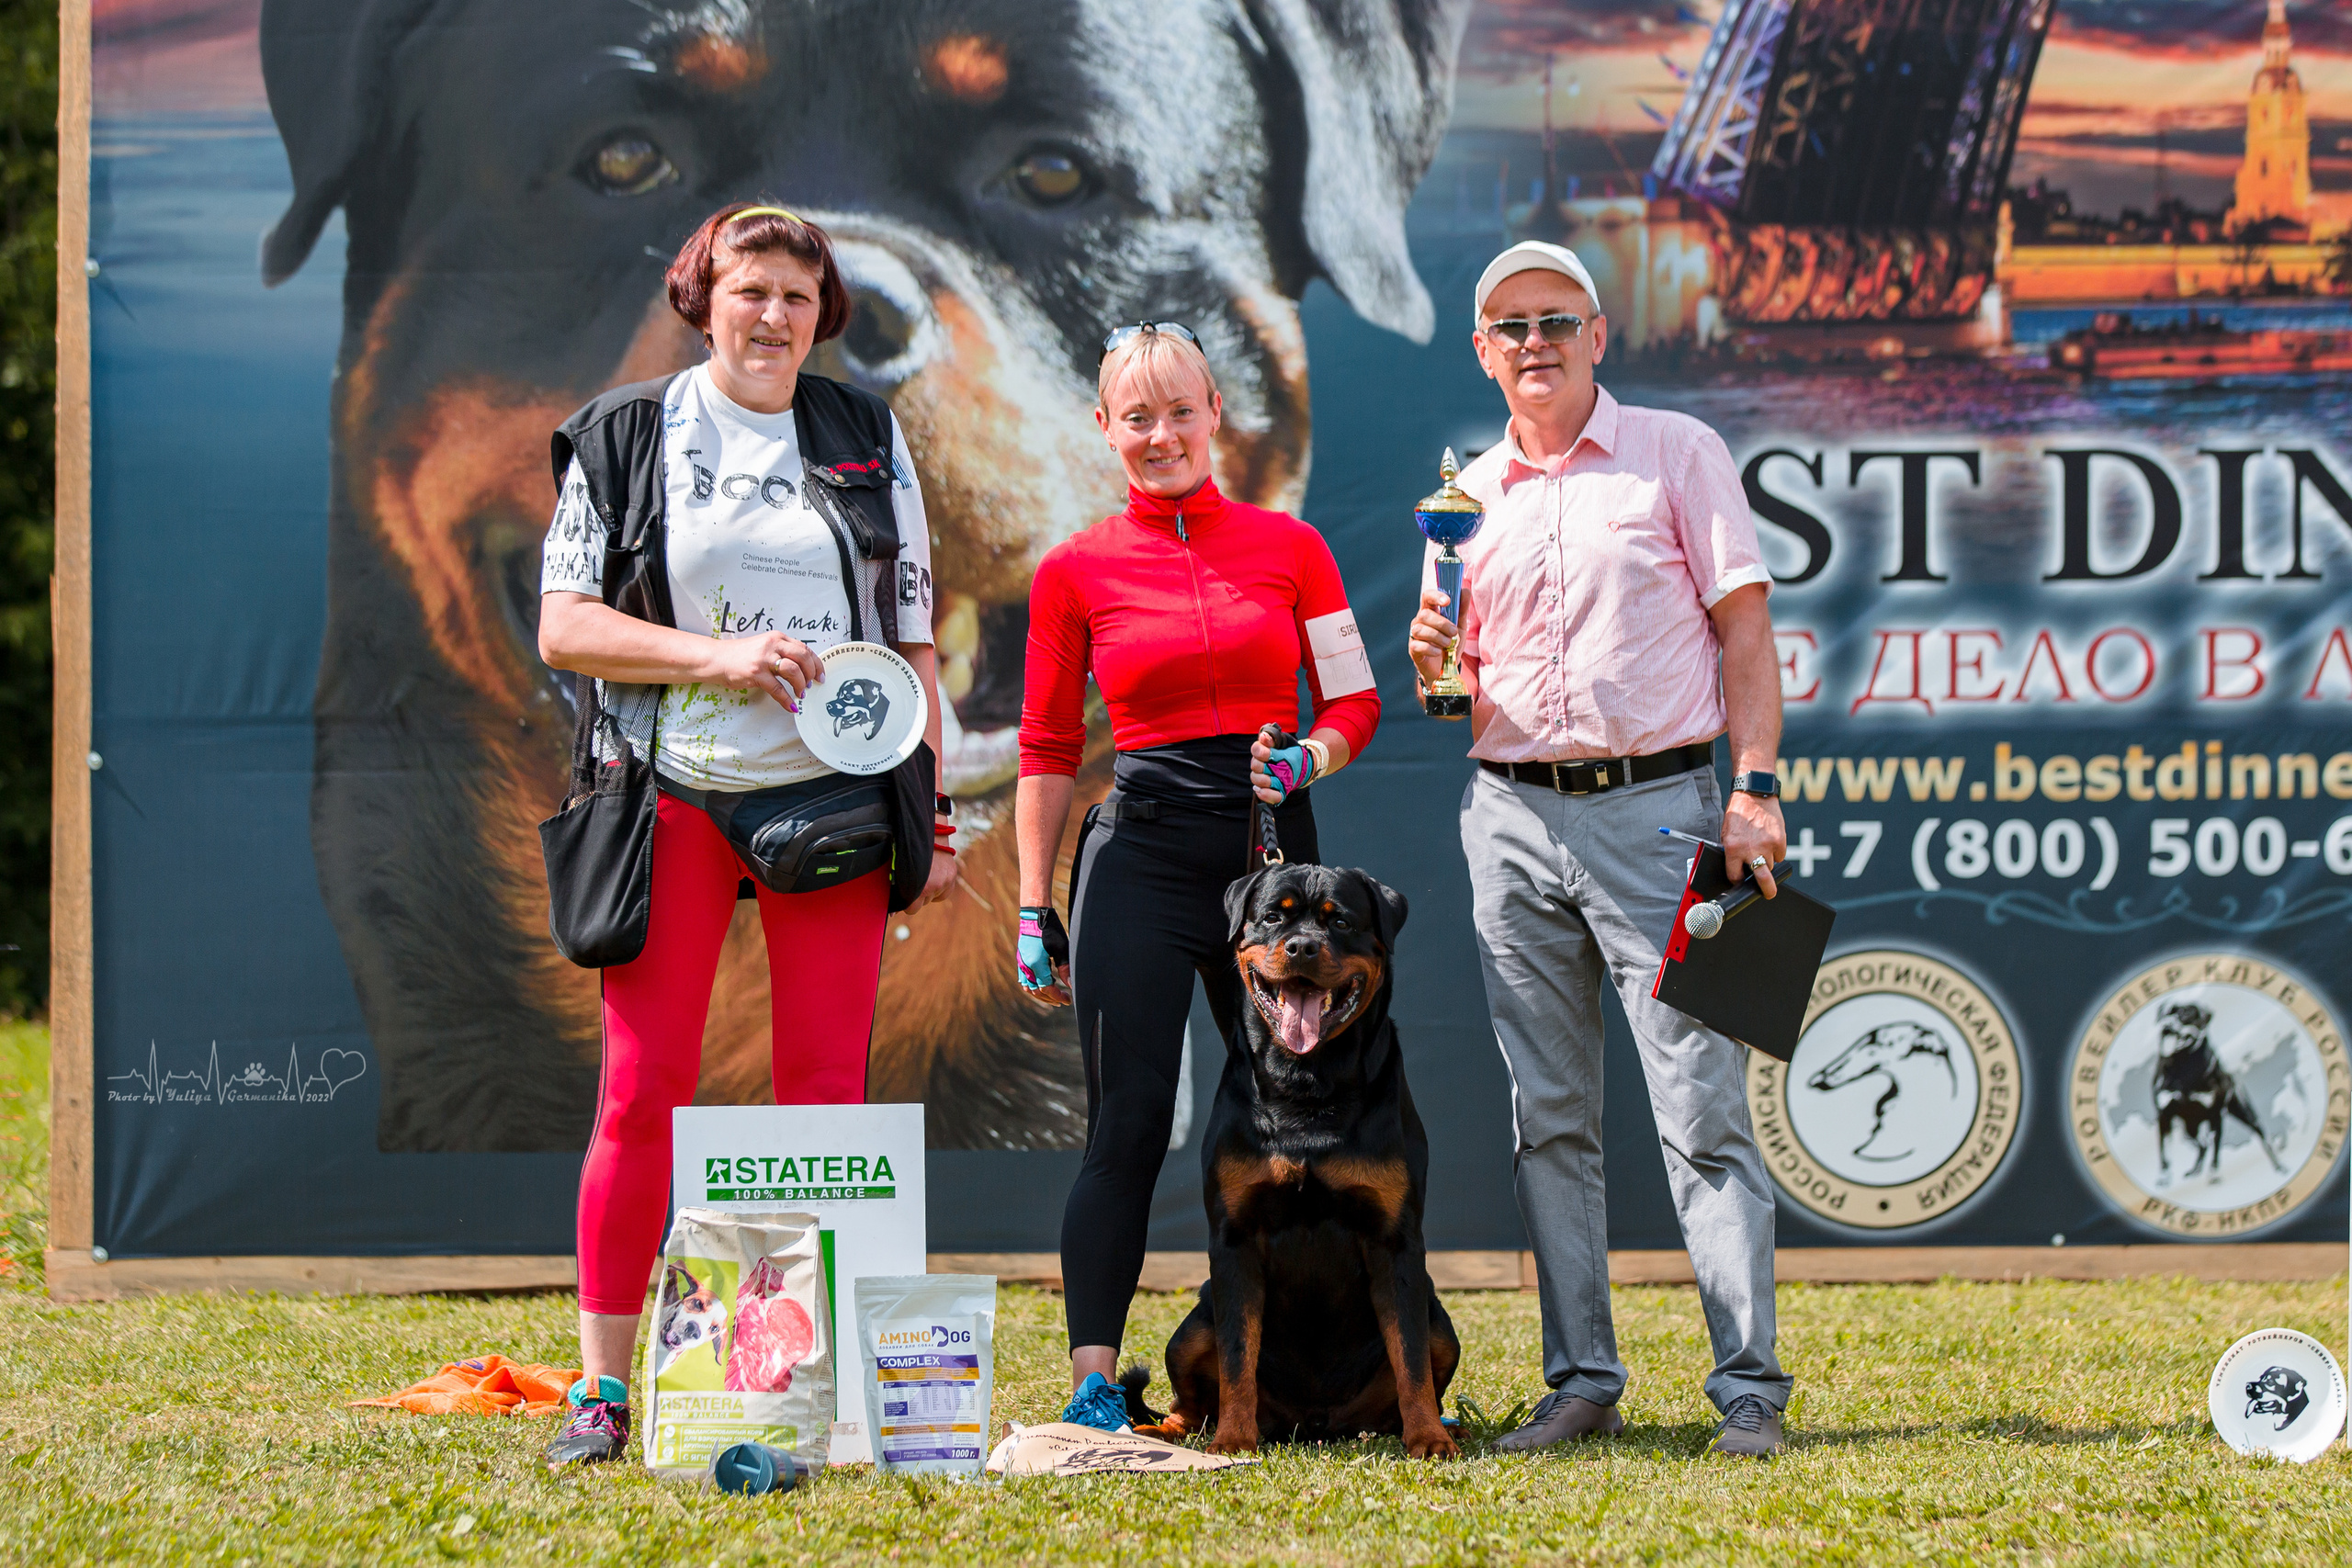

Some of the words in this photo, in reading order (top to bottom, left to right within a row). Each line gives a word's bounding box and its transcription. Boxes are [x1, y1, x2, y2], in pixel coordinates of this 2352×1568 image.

[1739, 447, 1981, 585] ST
[742, 552, 774, 564] Chinese
[774, 557, 801, 568] People
[741, 562, 776, 574] Celebrate
[777, 566, 808, 577] Chinese
[808, 569, 839, 581] Festivals
[786, 610, 840, 633] make
[821, 647, 865, 662] ТВЕЙЛЕРОВ
[1849, 627, 2157, 717] ДЕЛО
[2199, 627, 2267, 701] В
[1911, 818, 2120, 892] (800)
[2076, 965, 2183, 1164] РОТВЕЙЛЕР
[2204, 958, 2300, 1007] КЛУБ
[2303, 1009, 2350, 1161] РОССИИ
[1756, 1062, 1849, 1211] РОССИЙСКА
[1808, 962, 2001, 1055] ОЛОГИЧЕСКАЯ
[1916, 1060, 2011, 1211] ФЕДЕРАЦИЯ
[735, 1156, 896, 1184] STATERA
[733, 1189, 775, 1200] 100%
[785, 1188, 866, 1200] BALANCE
[879, 1356, 942, 1368] COMPLEX
[673, 1397, 744, 1411] STATERA
[951, 1449, 969, 1459] 1000
